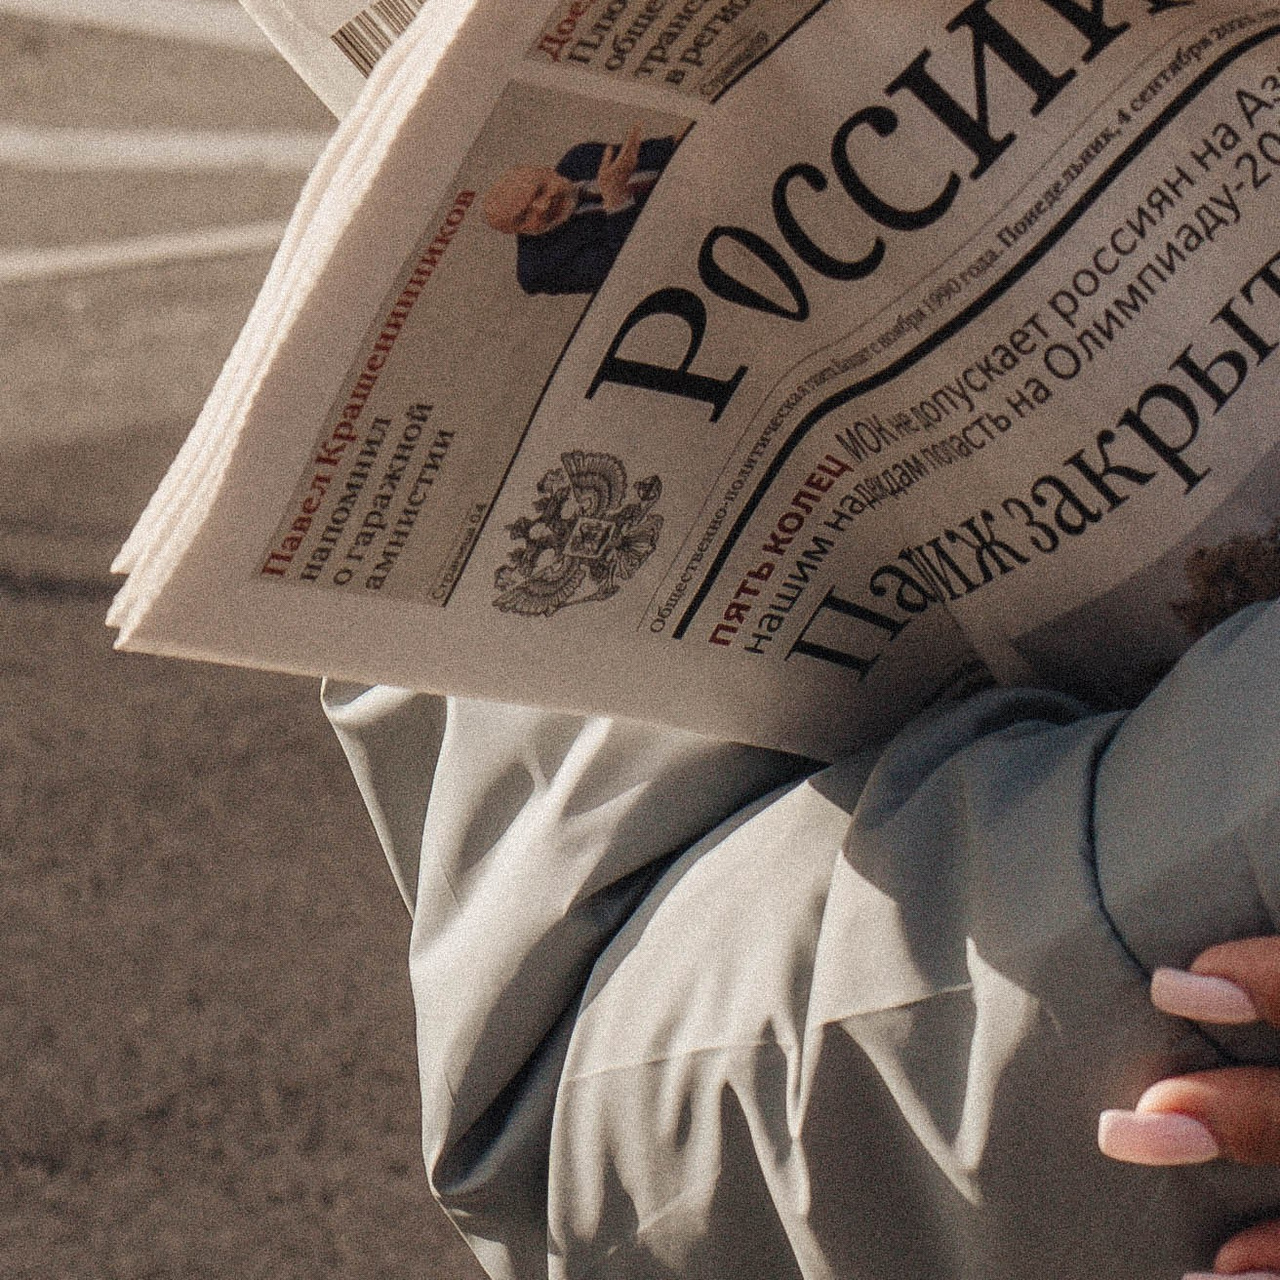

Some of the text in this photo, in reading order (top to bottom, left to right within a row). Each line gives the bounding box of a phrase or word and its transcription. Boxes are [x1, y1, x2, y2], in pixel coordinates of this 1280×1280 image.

[664, 68, 686, 86] в
[261, 188, 476, 578] Павел Крашенинников
[650, 382, 808, 634] Общественно-политическая
[925, 279, 962, 317] 1990
[960, 251, 1001, 288] года.
[999, 128, 1122, 246] Понедельник,
[1116, 108, 1133, 126] 4
[1130, 37, 1213, 113] сентября
[708, 560, 774, 647] ПЯТЬ
[762, 454, 856, 557] КОЛЕЦ
[891, 405, 921, 441] не
[911, 312, 1050, 432] допускает
[1048, 163, 1197, 328] россиян
[1190, 121, 1241, 172] на
[300, 415, 393, 583] напомнил
[332, 400, 434, 587] о гаражной
[365, 427, 457, 590] амнистии
[743, 535, 836, 654] нашим
[823, 450, 929, 532] надеждам
[921, 411, 1013, 471] попасть
[1006, 374, 1053, 420] на
